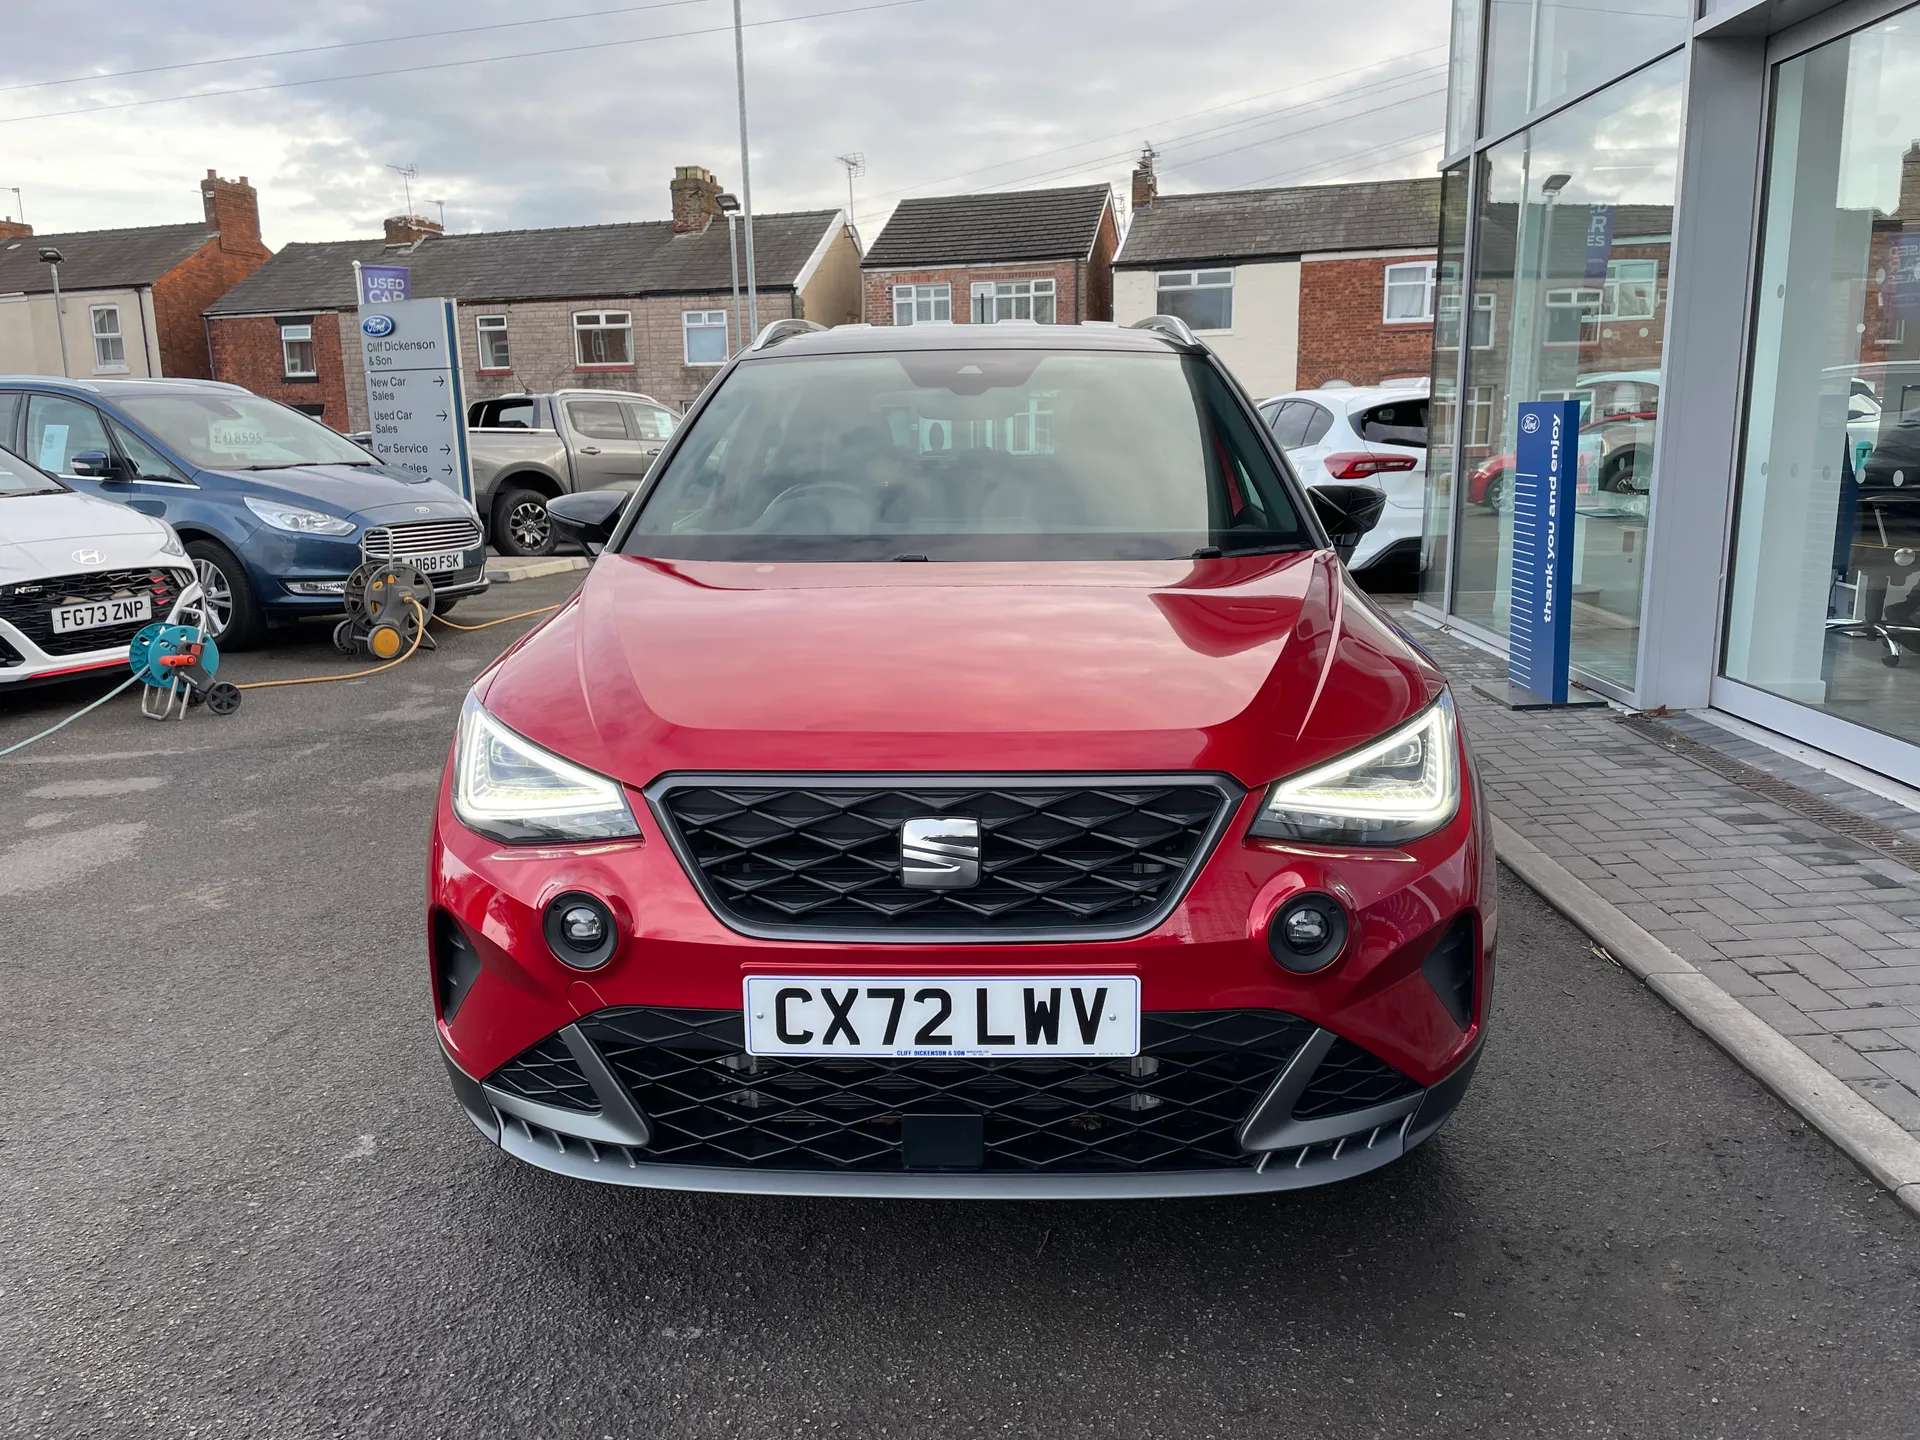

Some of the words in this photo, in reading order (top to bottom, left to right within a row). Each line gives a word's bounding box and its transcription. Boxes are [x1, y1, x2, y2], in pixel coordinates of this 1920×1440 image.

[367, 276, 405, 290] USED
[367, 341, 383, 353] Cliff
[384, 340, 436, 352] Dickenson
[368, 356, 375, 366] &
[375, 355, 393, 366] Son
[370, 377, 389, 387] New
[390, 376, 407, 387] Car
[372, 390, 395, 401] Sales
[374, 411, 395, 421] Used
[396, 409, 413, 421] Car
[375, 423, 399, 434] Sales
[377, 443, 392, 454] Car
[393, 442, 429, 454] Service
[1550, 413, 1561, 473] enjoy
[1548, 476, 1557, 518] and
[1547, 521, 1555, 559] you
[439, 553, 460, 569] FSK
[1543, 563, 1554, 623] thank
[60, 605, 108, 628] FG73
[111, 600, 144, 621] ZNP
[774, 987, 953, 1046] CX72
[976, 987, 1109, 1046] LWV
